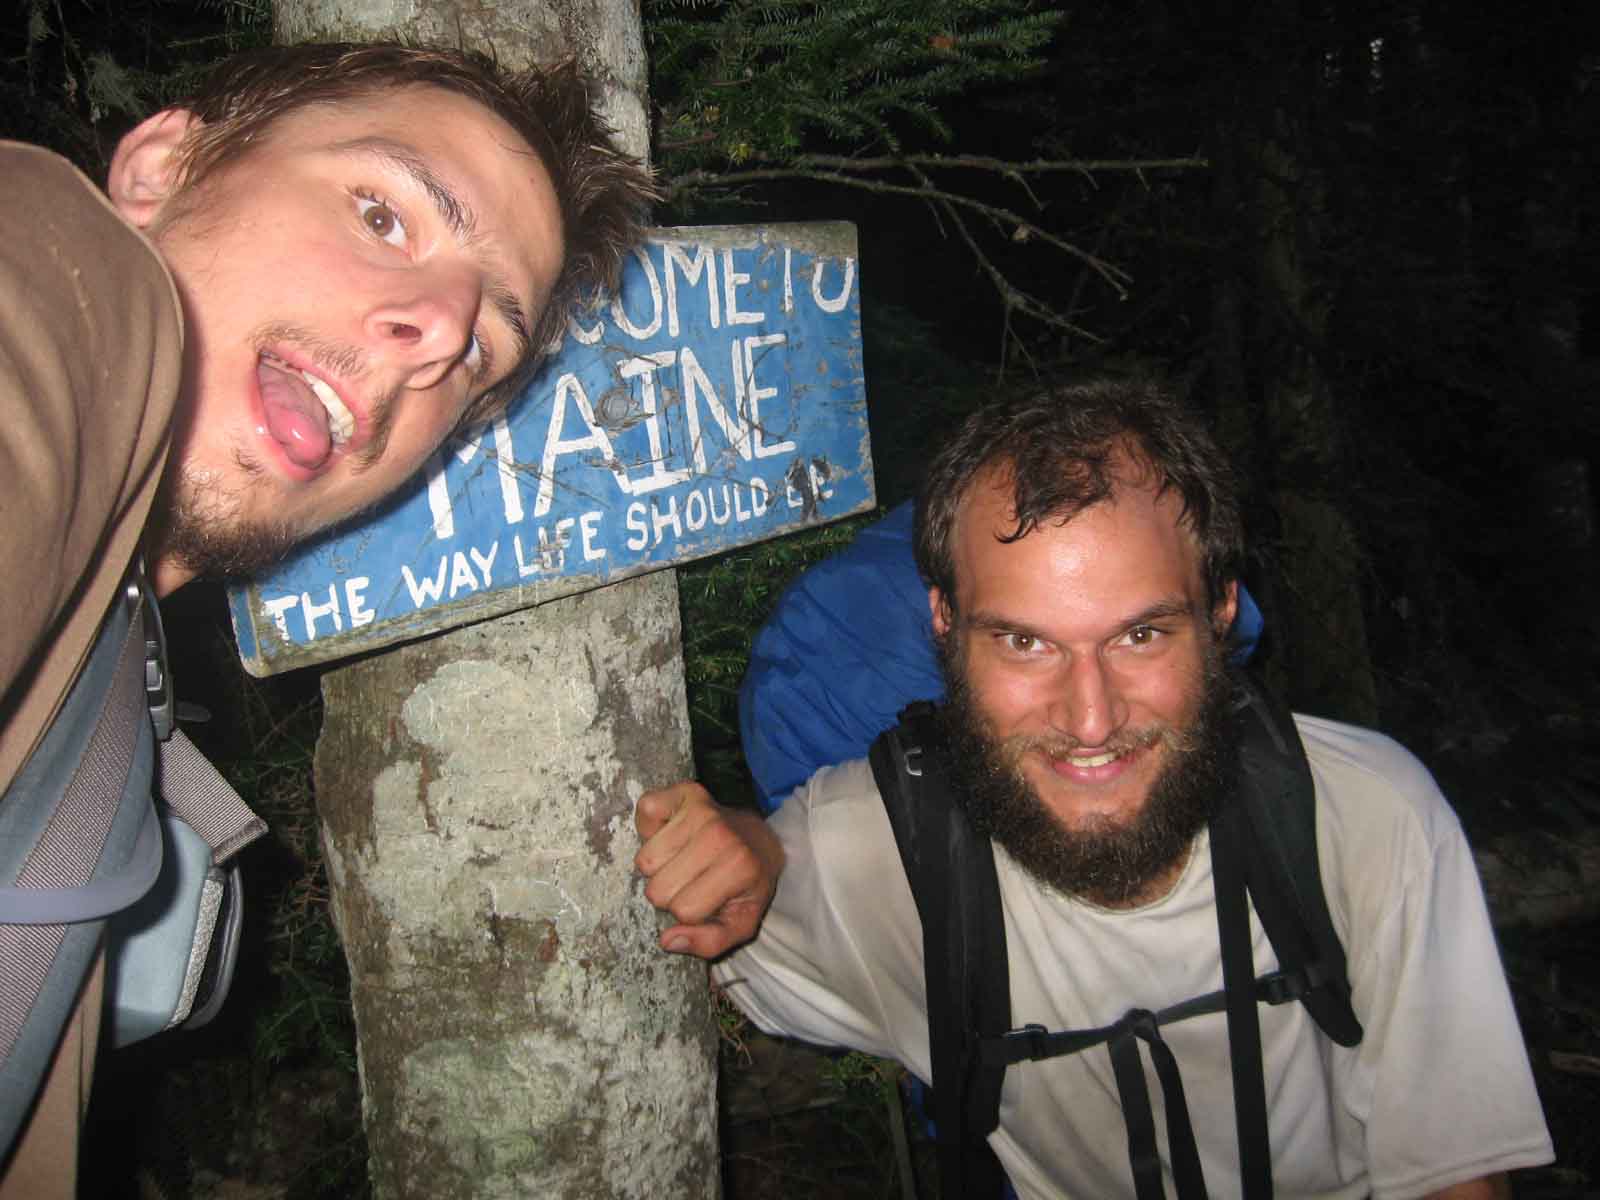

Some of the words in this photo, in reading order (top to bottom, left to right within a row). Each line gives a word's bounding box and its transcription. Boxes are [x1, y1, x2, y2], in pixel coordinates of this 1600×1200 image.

[427, 332, 797, 540] MAINE
[261, 576, 376, 646] THE
[401, 541, 499, 608] WAY
[513, 511, 607, 577] LIFE
[626, 477, 770, 551] SHOULD
